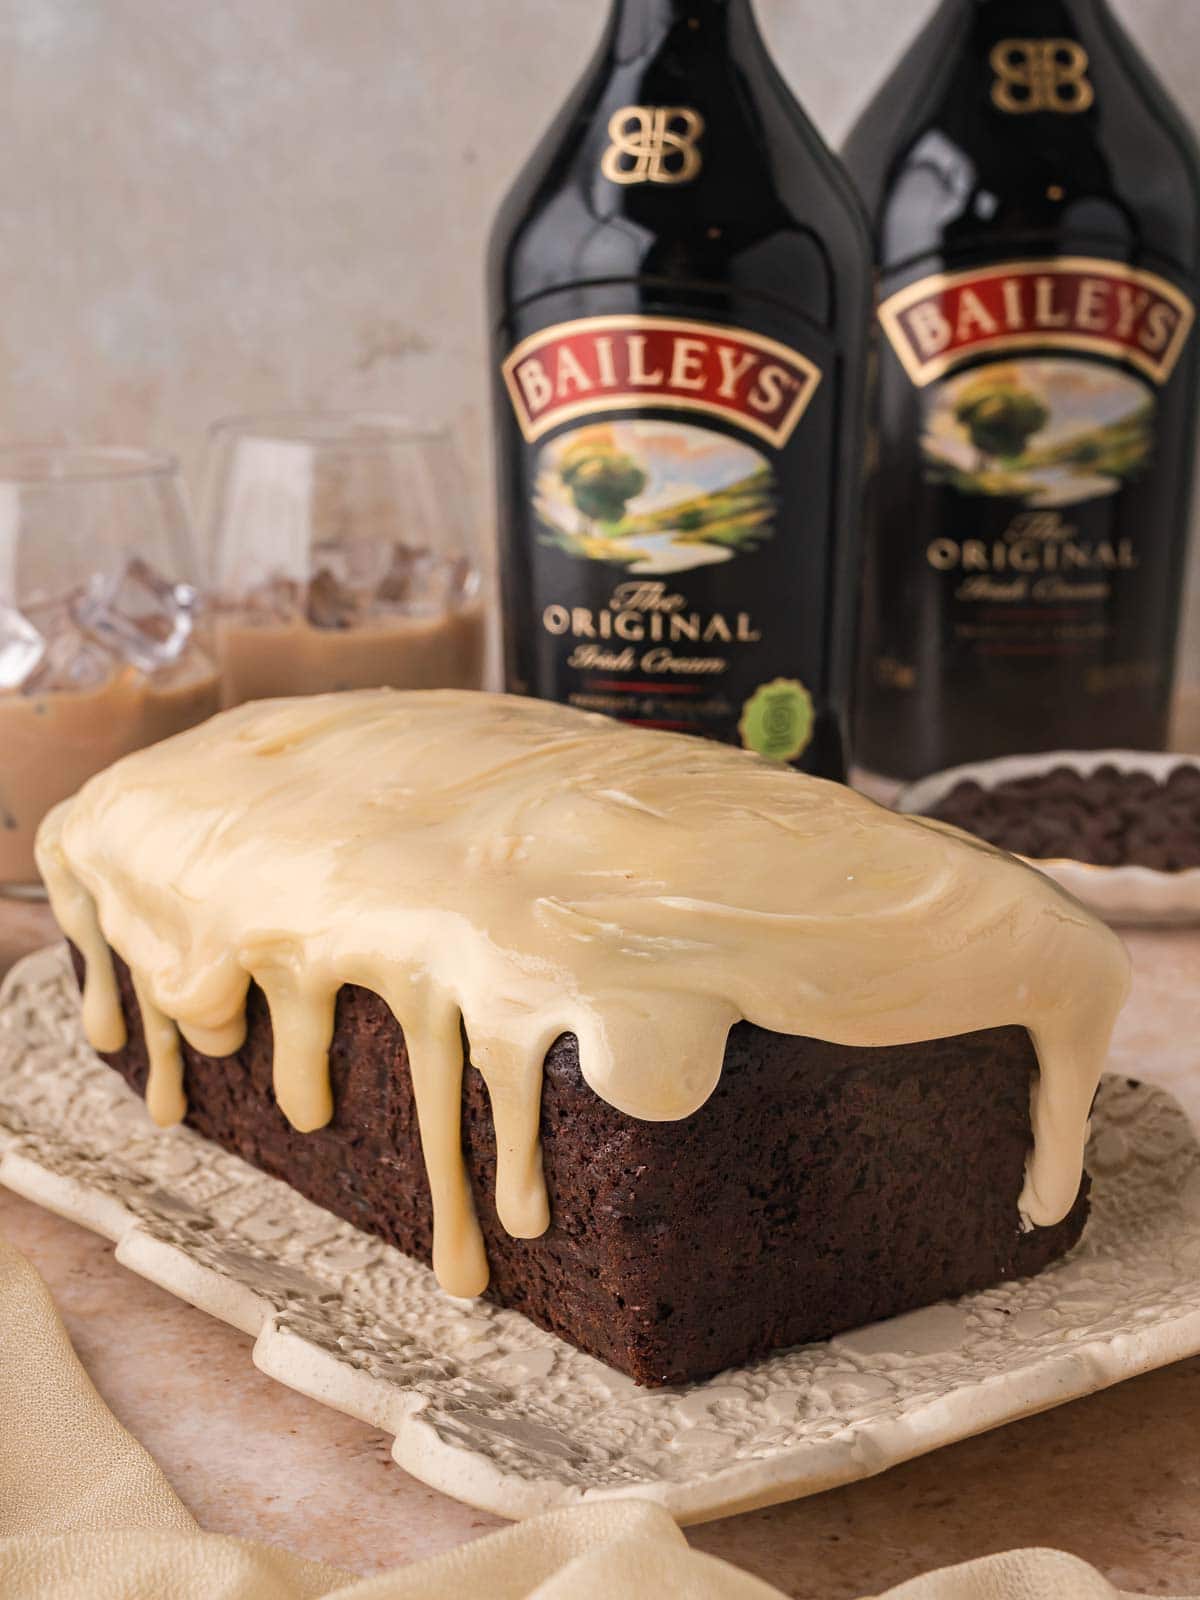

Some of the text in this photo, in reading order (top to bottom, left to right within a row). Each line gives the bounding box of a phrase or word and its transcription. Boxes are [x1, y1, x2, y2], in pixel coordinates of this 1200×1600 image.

[907, 278, 1177, 356] BAILEYS
[516, 335, 794, 415] BAILEYS
[926, 537, 1138, 572] ORIGINAL
[542, 604, 762, 642] ORIGINAL
